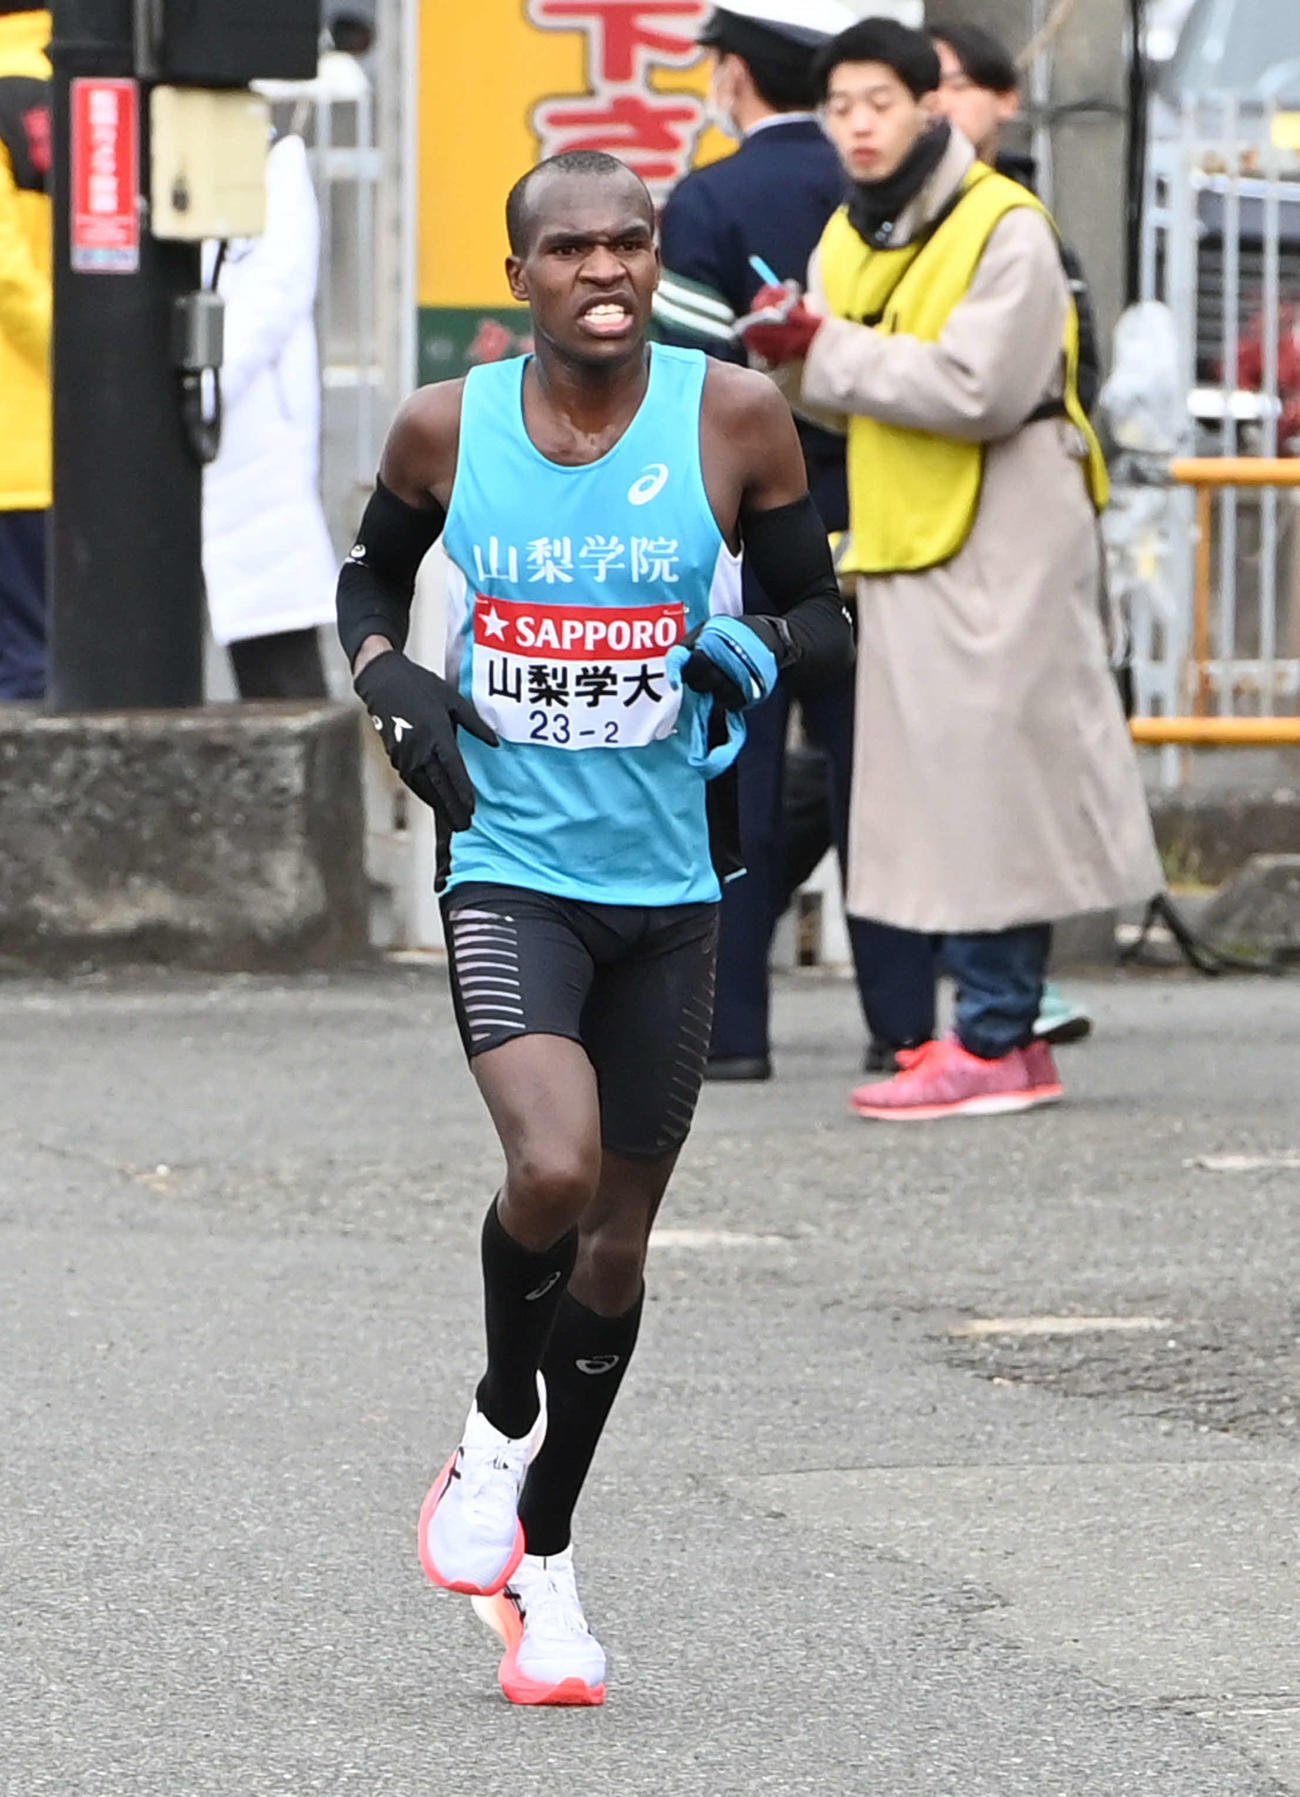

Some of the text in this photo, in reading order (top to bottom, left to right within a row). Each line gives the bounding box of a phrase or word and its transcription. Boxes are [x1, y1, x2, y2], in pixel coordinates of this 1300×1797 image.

[540, 0, 704, 181] 下さ
[473, 535, 680, 583] 山梨学院
[515, 616, 677, 651] SAPPORO
[488, 657, 665, 708] 山梨学大
